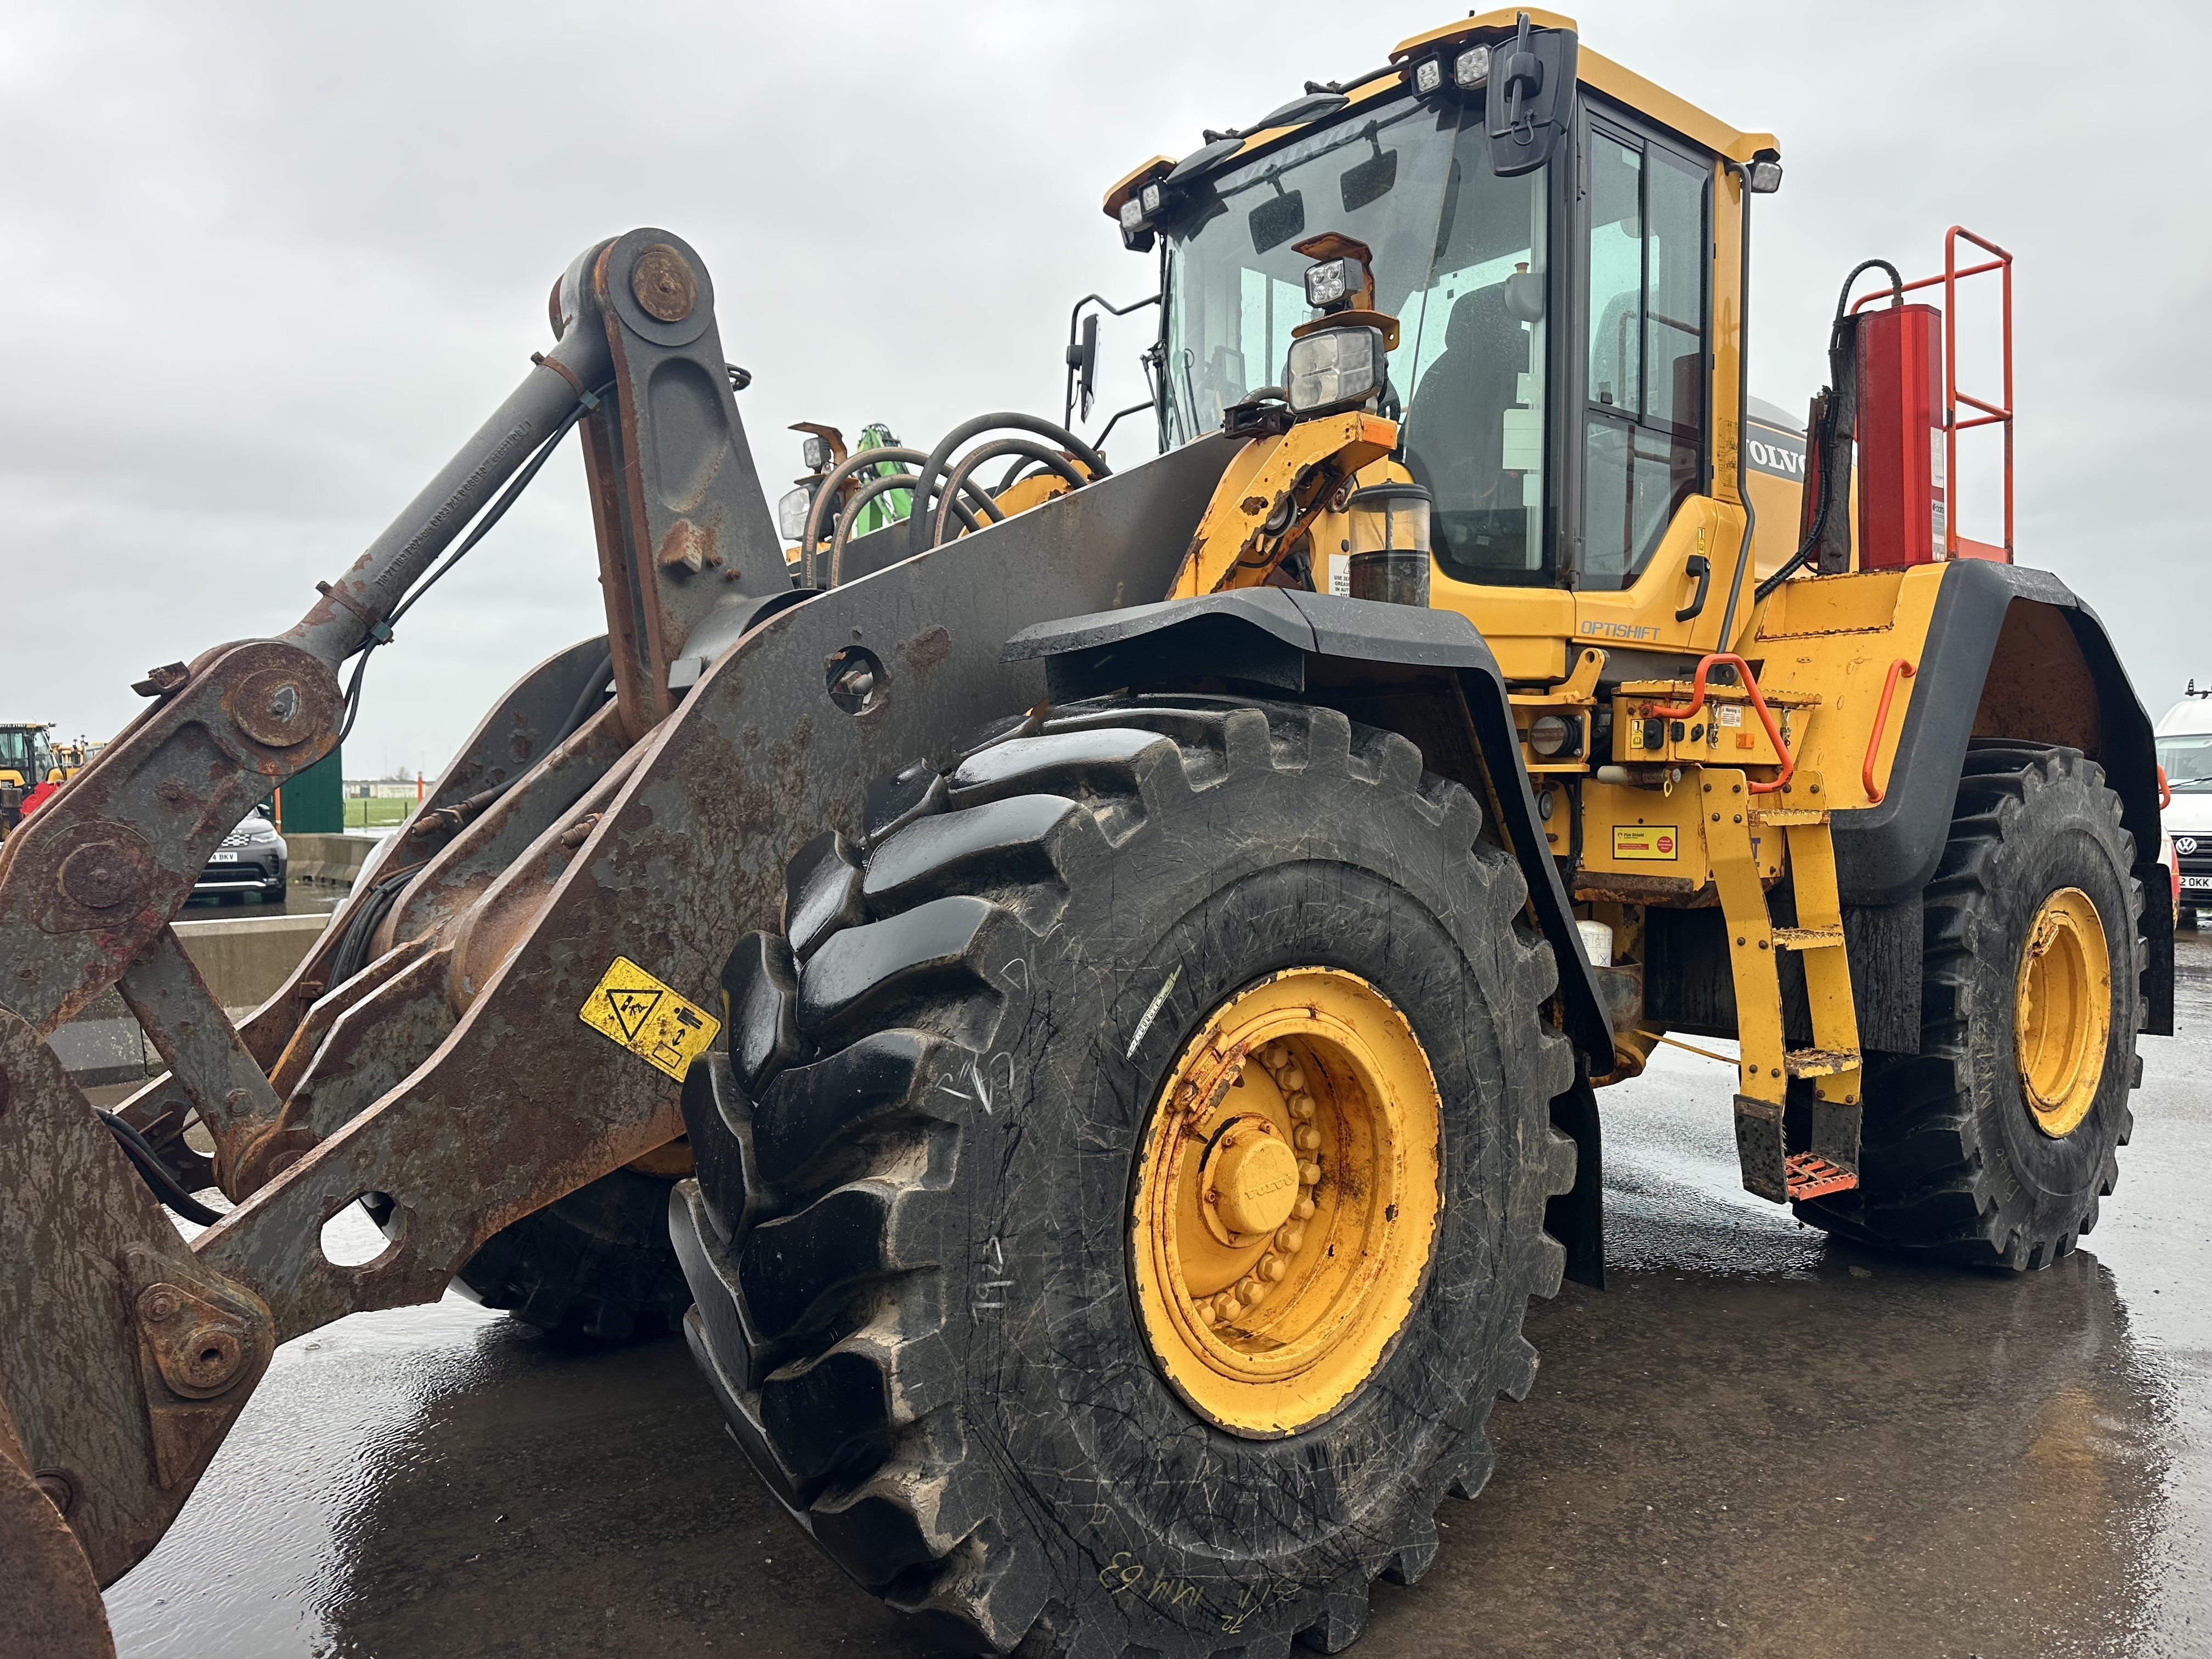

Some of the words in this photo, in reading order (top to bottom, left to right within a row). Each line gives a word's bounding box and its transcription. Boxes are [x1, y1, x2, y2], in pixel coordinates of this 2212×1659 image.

[1746, 439, 1805, 474] OLV
[1581, 620, 1661, 640] OPTISHIFT
[1244, 1174, 1295, 1200] VOLVO
